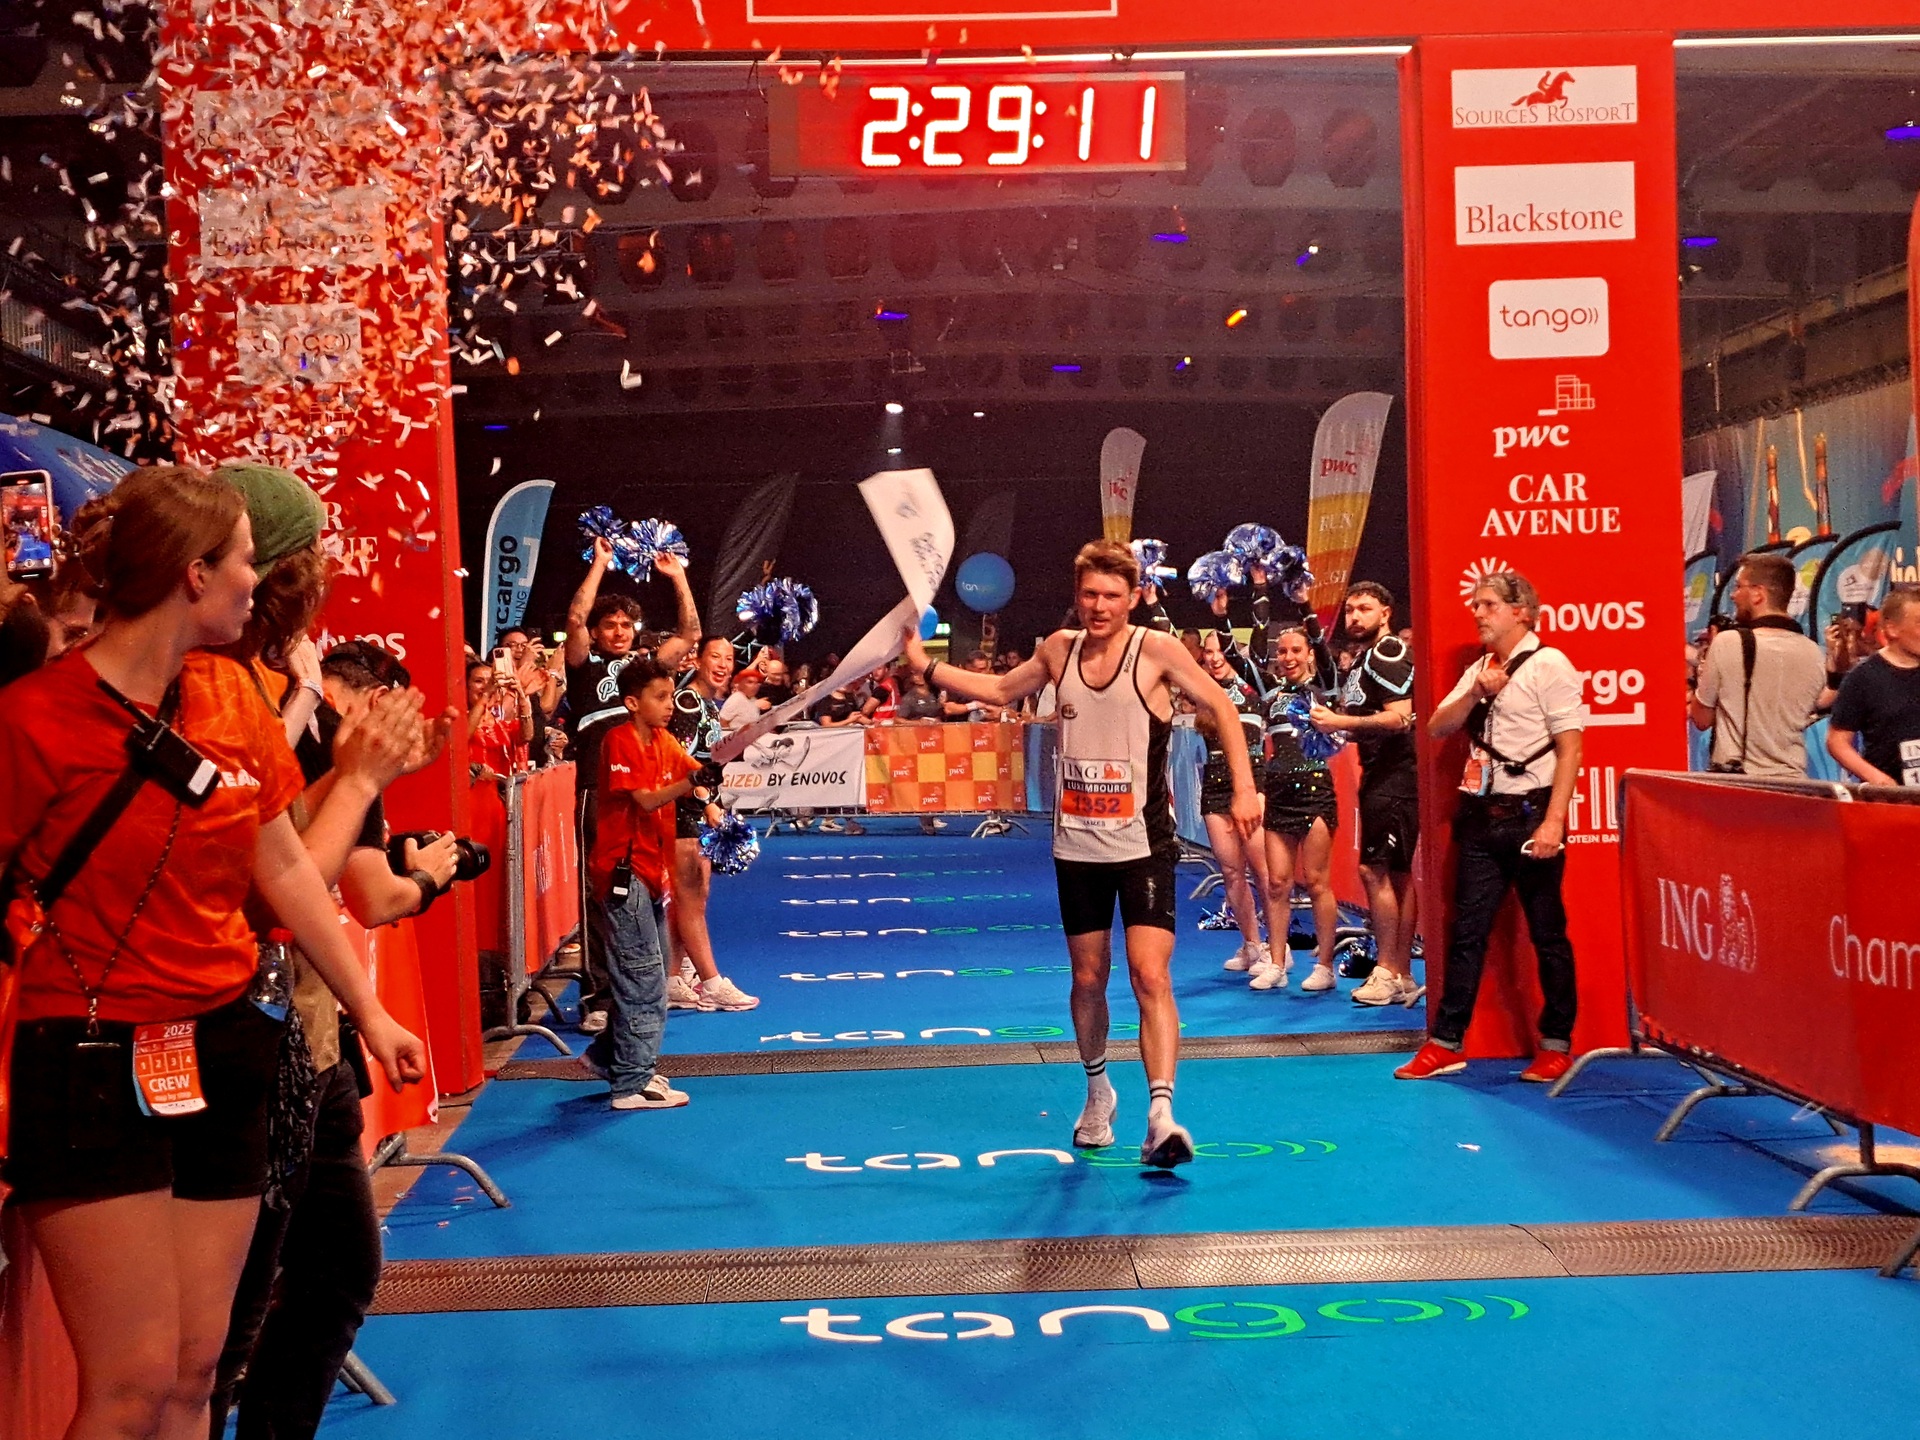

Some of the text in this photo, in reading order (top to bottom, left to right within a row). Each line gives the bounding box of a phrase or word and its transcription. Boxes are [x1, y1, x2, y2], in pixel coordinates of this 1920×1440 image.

[861, 85, 1156, 167] 2:29:11
[1466, 203, 1624, 234] Blackstone
[1492, 424, 1570, 458] pwc
[1320, 457, 1358, 477] pwc
[1508, 472, 1589, 504] CAR
[1480, 507, 1621, 537] AVENUE
[1534, 601, 1645, 632] novos
[1578, 668, 1645, 705] rgo
[920, 741, 937, 749] pwc
[722, 770, 848, 788] GIZED BY ENOVOS
[893, 768, 910, 776] pwc
[948, 767, 965, 775] pwc
[1067, 762, 1098, 779] ING
[922, 795, 939, 804] pwc
[1567, 834, 1600, 844] OTEIN
[1657, 877, 1713, 961] ING
[163, 1023, 194, 1039] 2025
[155, 1059, 162, 1068] 2
[171, 1057, 177, 1066] 3
[148, 1073, 190, 1093] CREW
[780, 1298, 1443, 1343] tango
